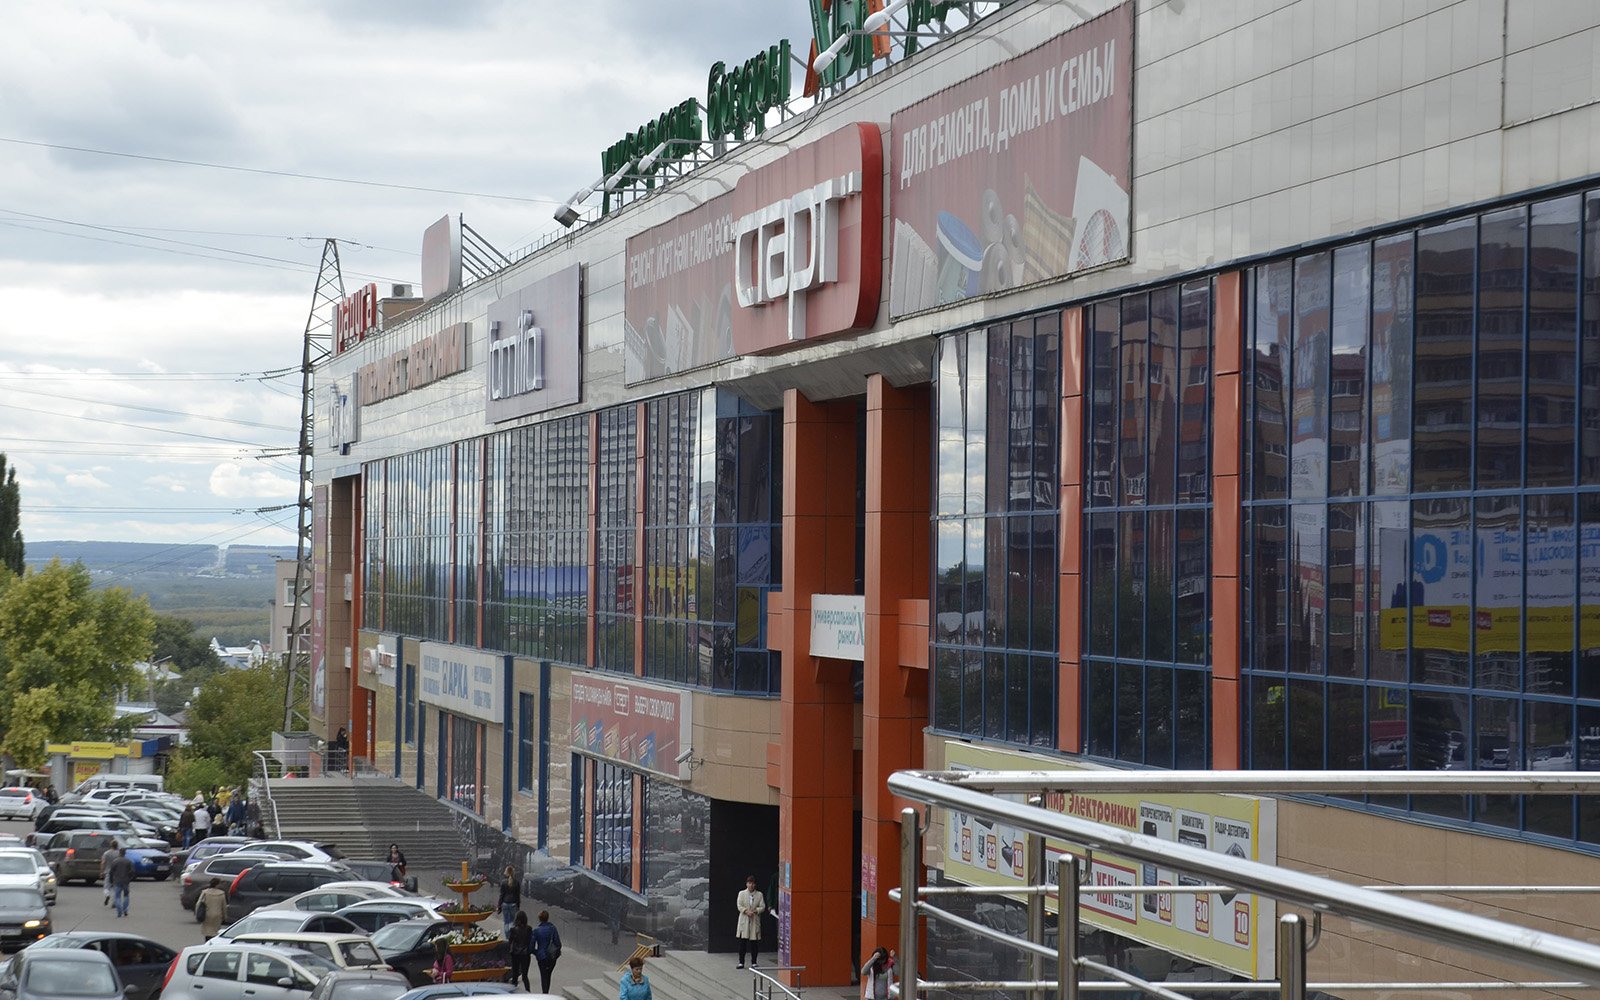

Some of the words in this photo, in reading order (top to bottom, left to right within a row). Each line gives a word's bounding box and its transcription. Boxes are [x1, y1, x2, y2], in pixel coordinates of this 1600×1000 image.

[900, 124, 927, 190] ДЛЯ
[929, 96, 995, 168] РЕМОНТА,
[997, 75, 1041, 153] ДОМА
[1044, 66, 1056, 124] И
[1059, 39, 1115, 116] СЕМЬИ
[1159, 891, 1171, 912] 30
[1195, 900, 1209, 921] 30
[1236, 911, 1248, 934] 10
